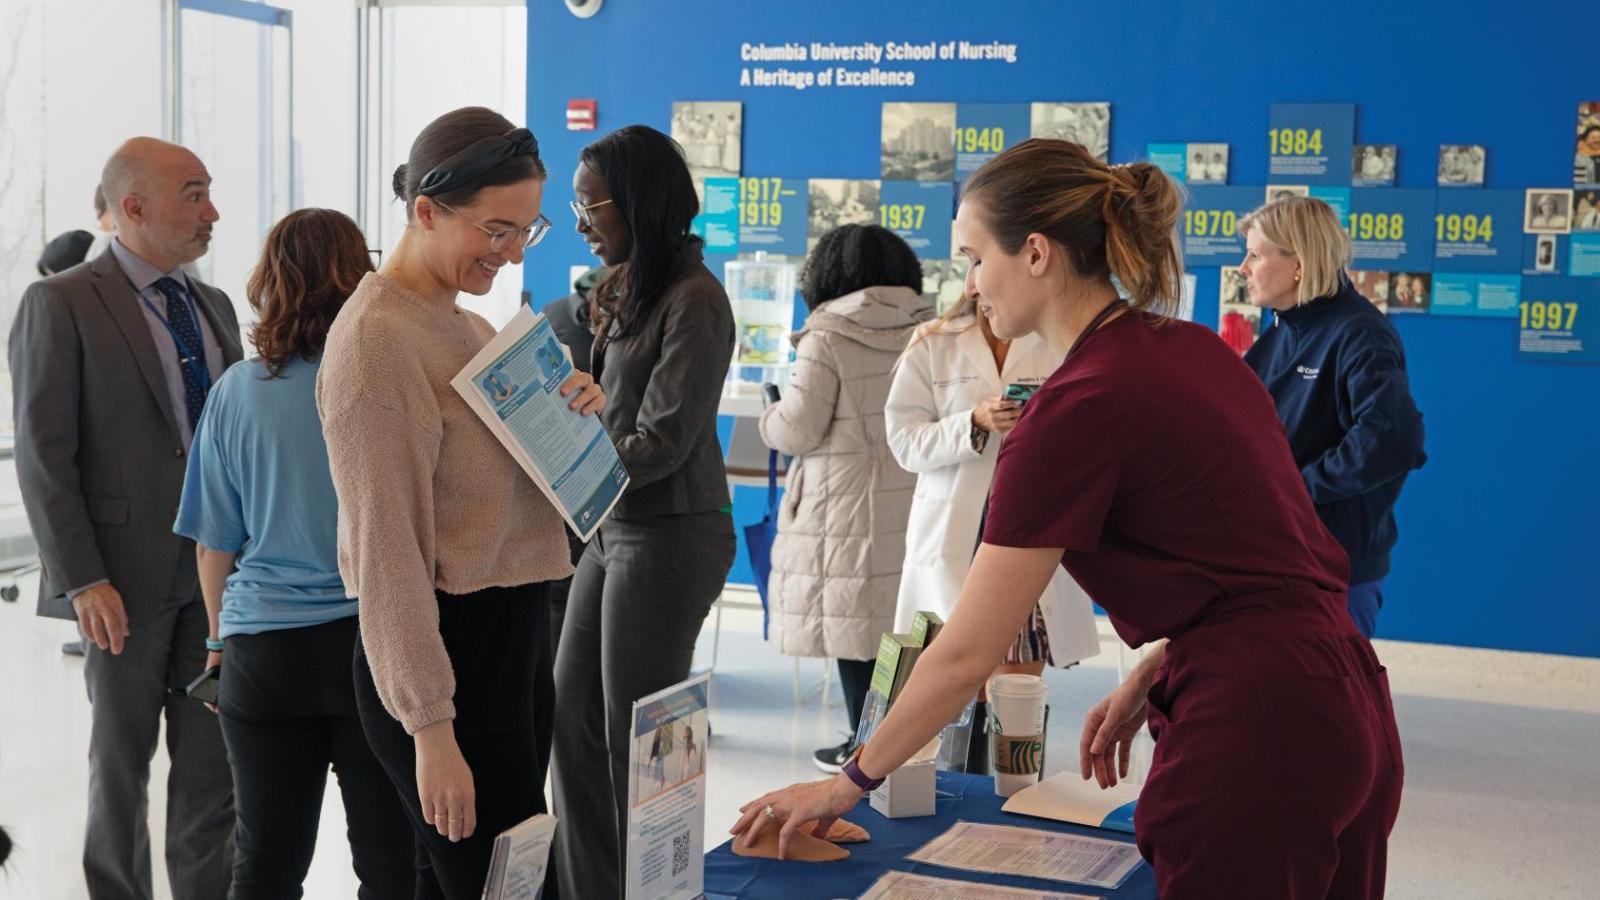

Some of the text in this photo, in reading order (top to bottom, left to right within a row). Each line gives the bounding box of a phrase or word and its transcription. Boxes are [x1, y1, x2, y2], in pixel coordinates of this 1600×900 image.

[741, 41, 1018, 64] Columbia University School of Nursing
[740, 67, 916, 90] A Heritage of Excellence
[955, 127, 1004, 153] 1940
[1269, 129, 1323, 155] 1984
[740, 202, 782, 226] 1919
[880, 205, 925, 229] 1937
[1185, 210, 1236, 236] 1970
[1349, 213, 1404, 241] 1988
[1436, 214, 1493, 242] 1994
[1520, 302, 1578, 329] 1997
